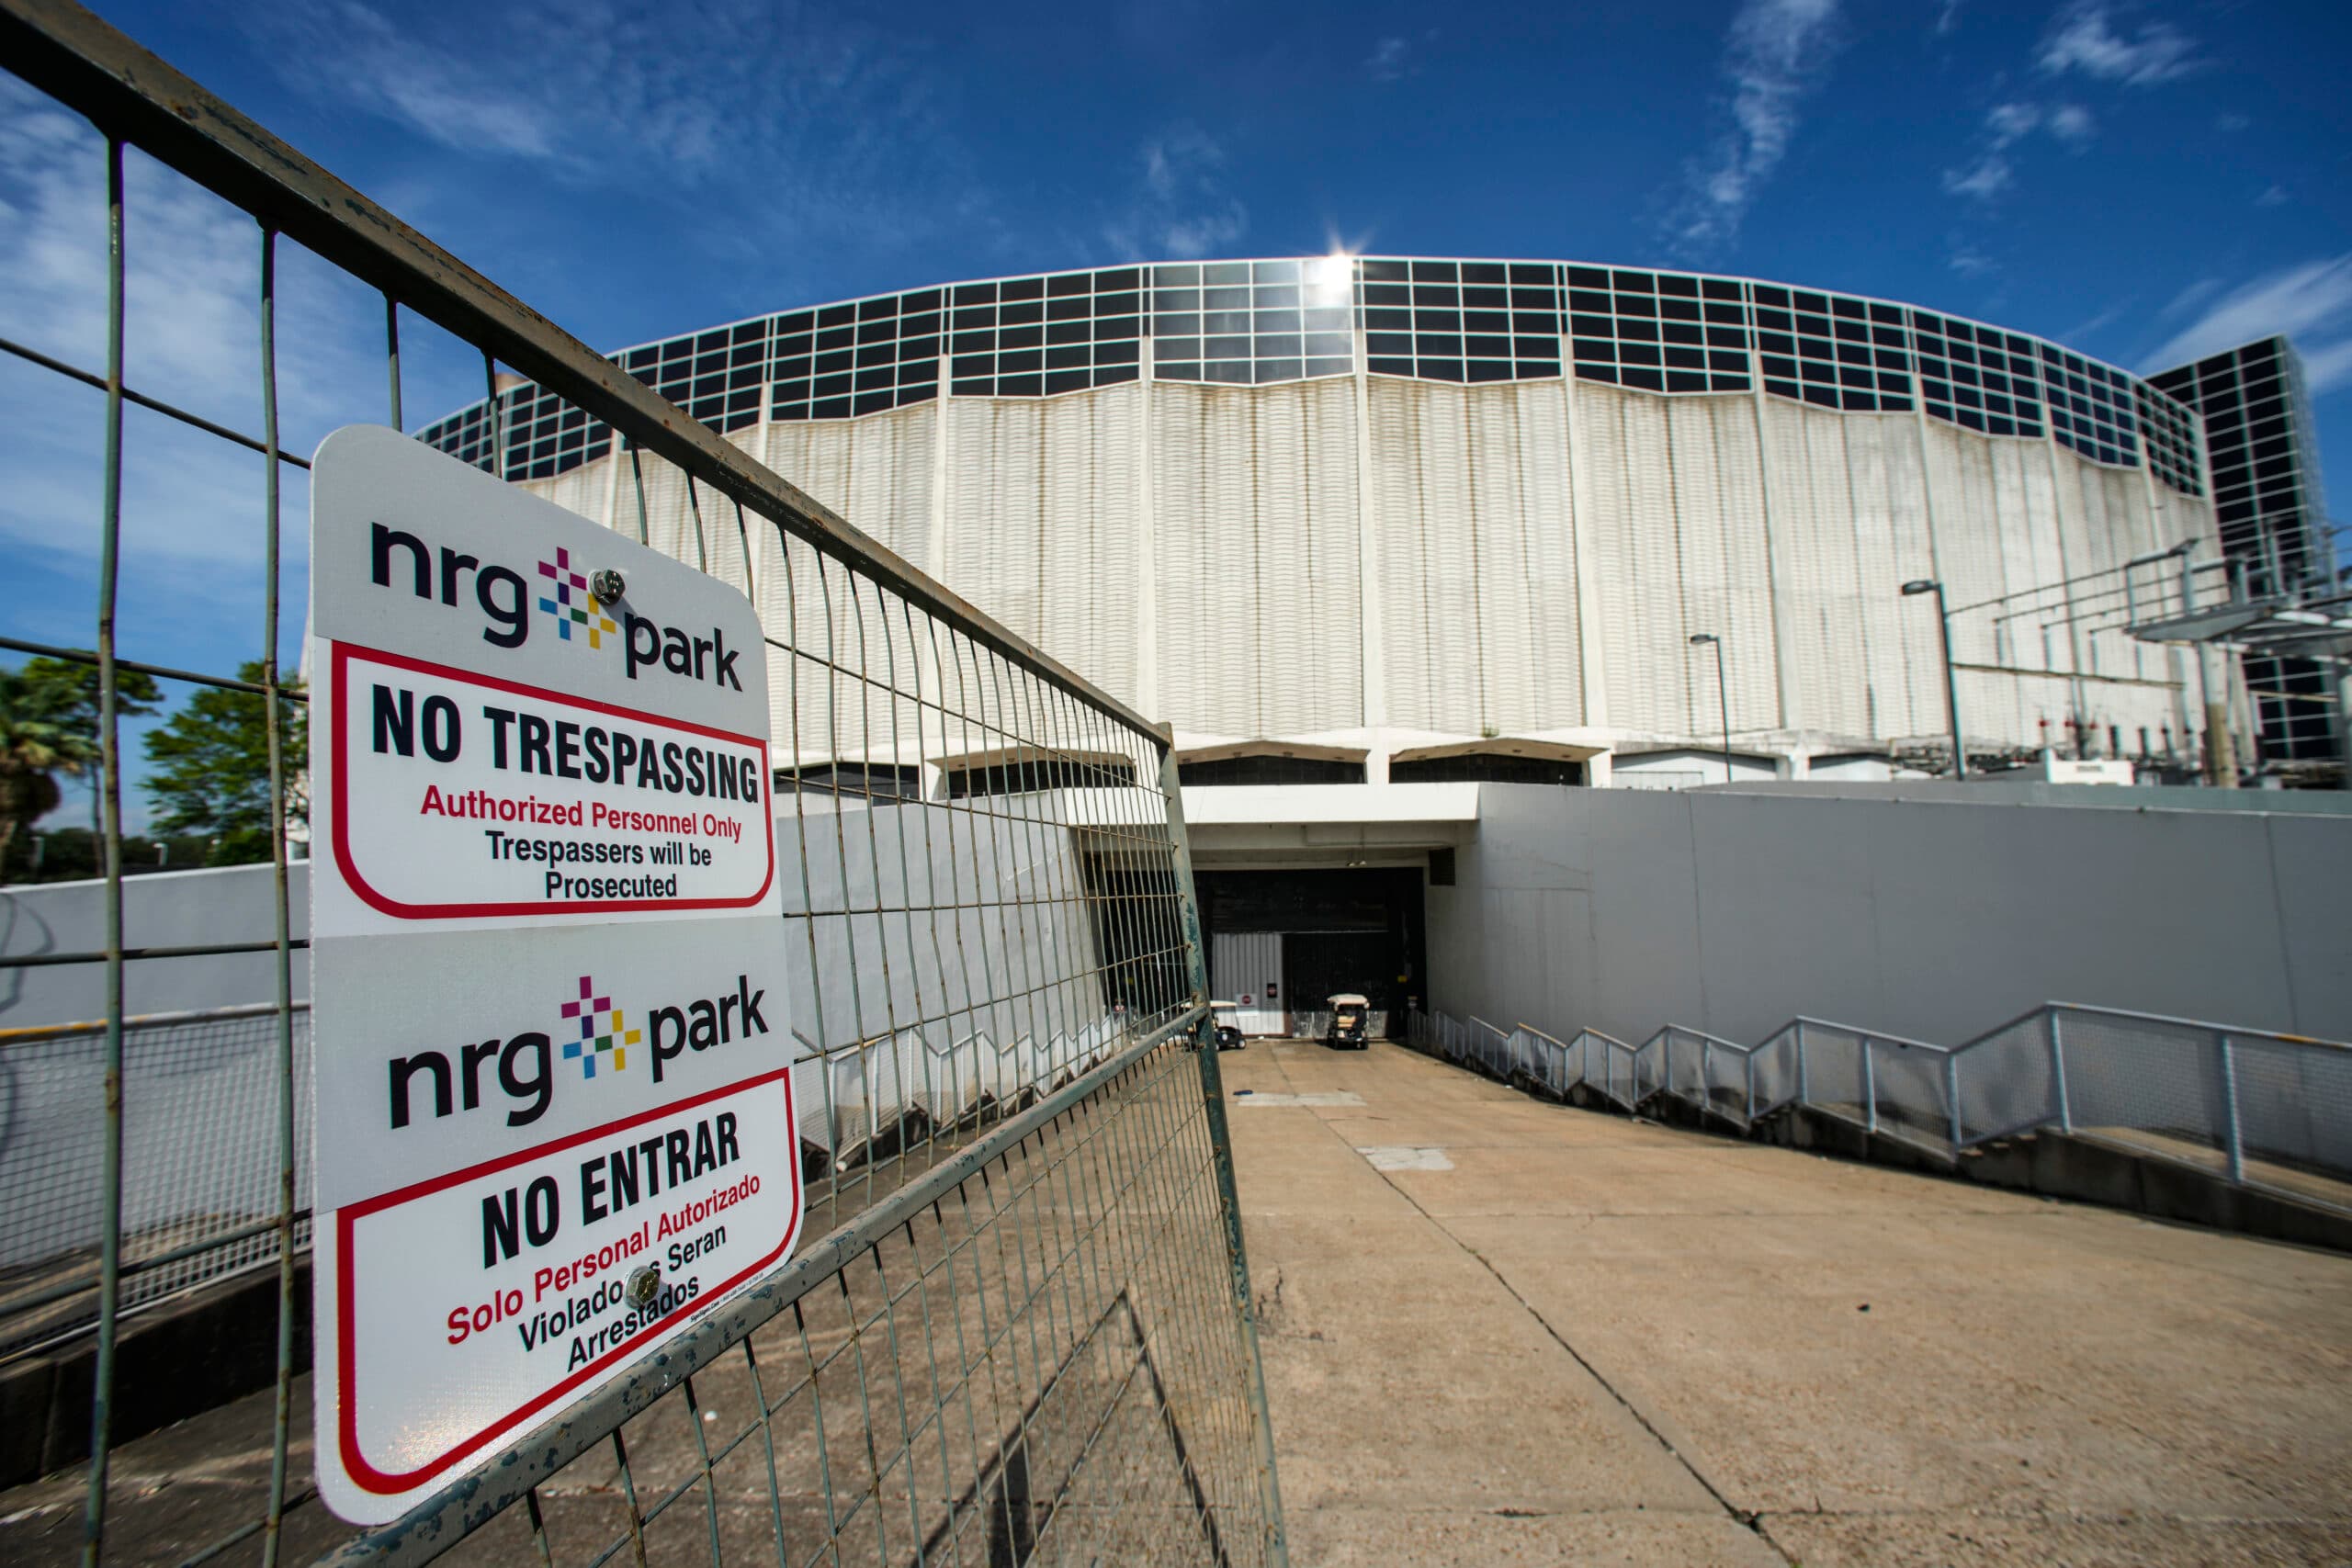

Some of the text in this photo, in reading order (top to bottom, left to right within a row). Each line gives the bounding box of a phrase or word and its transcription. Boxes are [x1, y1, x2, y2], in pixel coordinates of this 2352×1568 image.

[372, 522, 743, 693] nrg park
[372, 683, 759, 804] NO TRESPASSING
[421, 784, 742, 844] Authorized Personnel Only
[485, 829, 712, 869] Trespassers will be
[546, 870, 677, 899] Prosecuted
[390, 976, 769, 1129] nrg park
[483, 1111, 741, 1269] NO ENTRAR
[447, 1289, 524, 1346] Solo
[535, 1221, 650, 1303] Personal
[657, 1174, 762, 1242] Autorizado
[518, 1260, 661, 1352] Violados
[668, 1225, 727, 1273] Seran
[567, 1276, 699, 1373] Arrestados
